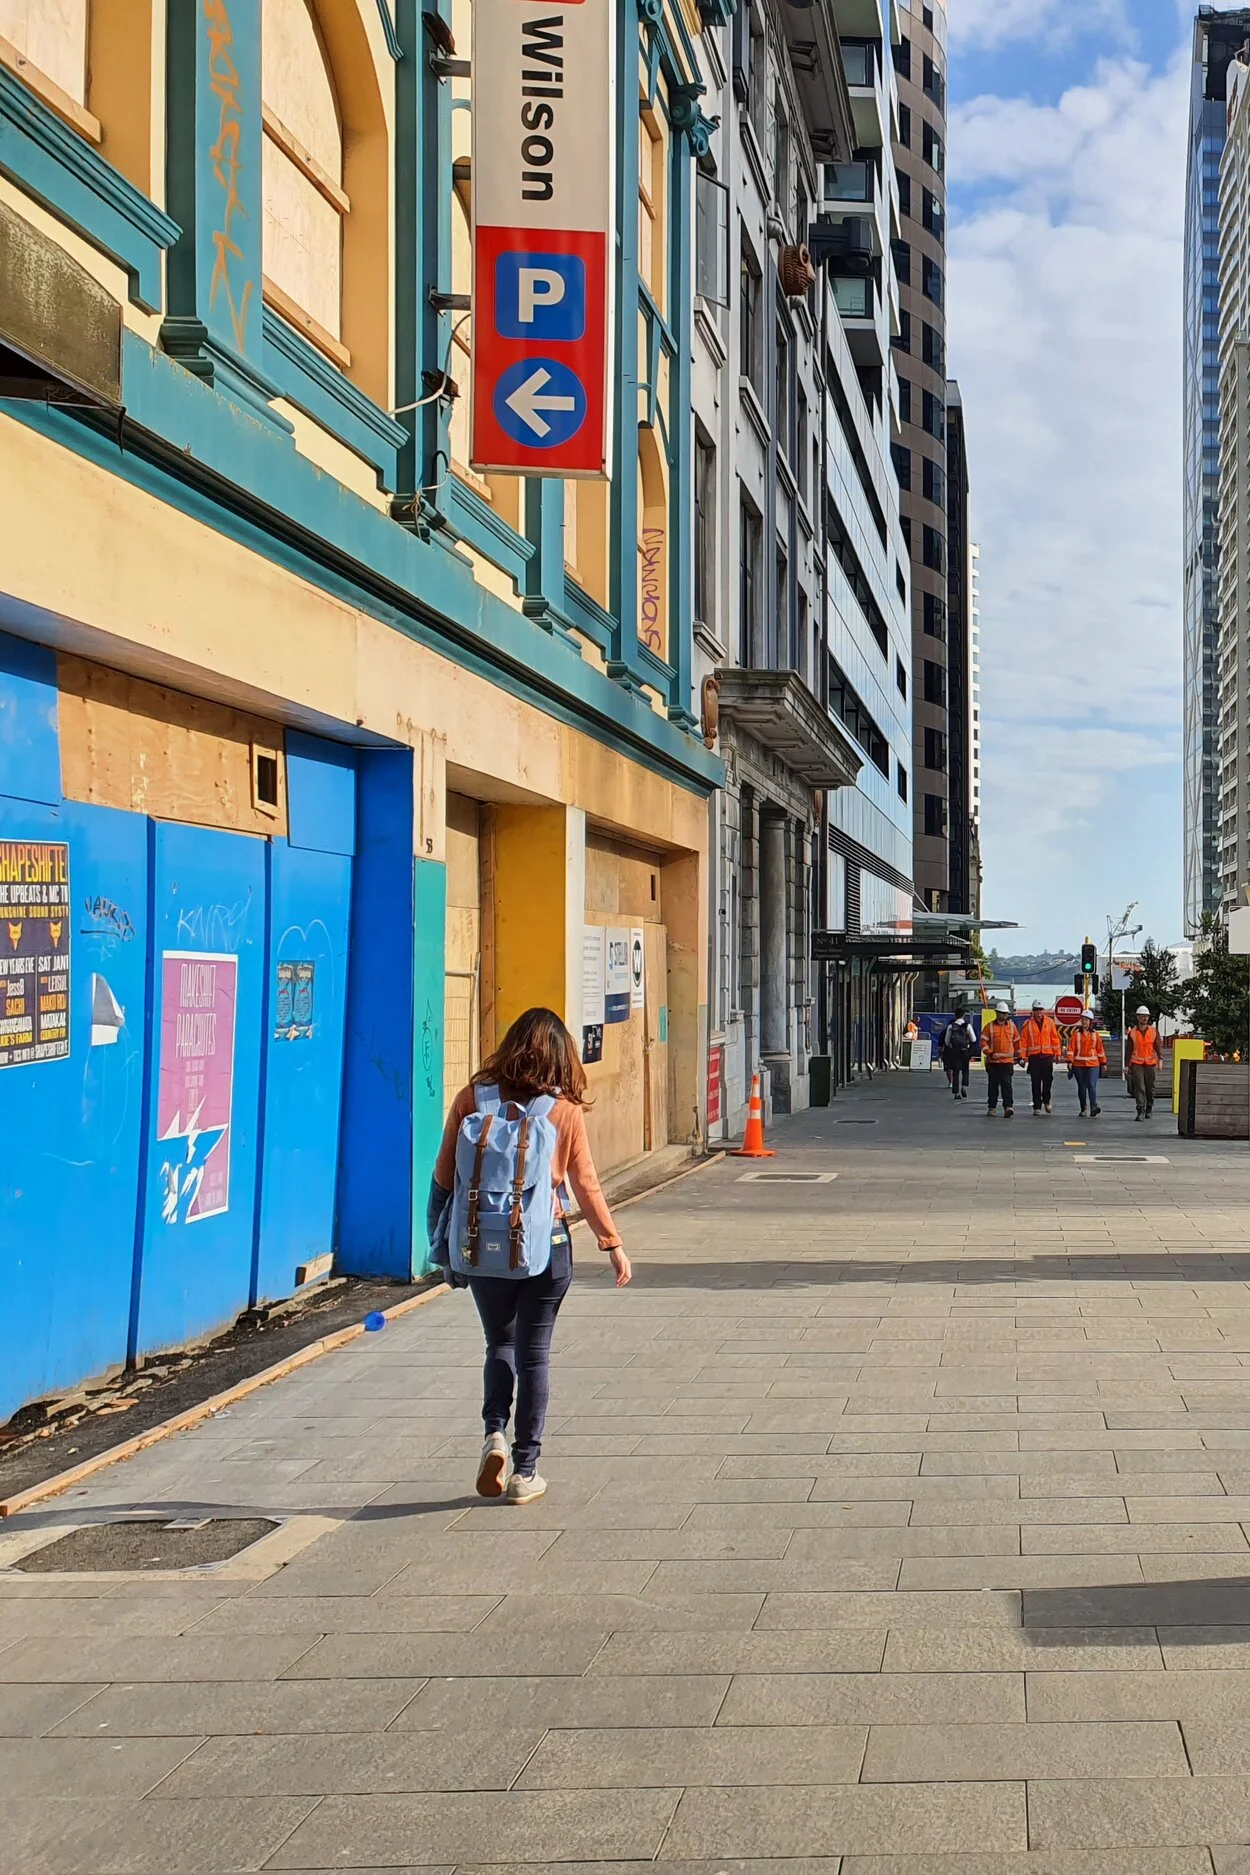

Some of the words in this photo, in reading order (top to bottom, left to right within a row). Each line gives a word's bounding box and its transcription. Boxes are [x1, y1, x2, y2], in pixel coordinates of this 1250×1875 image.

[520, 15, 564, 202] Wilson
[518, 267, 565, 323] P
[38, 956, 51, 972] SAT
[180, 963, 216, 1008] MAKESHIFT
[176, 1013, 216, 1058] PARACHUTES
